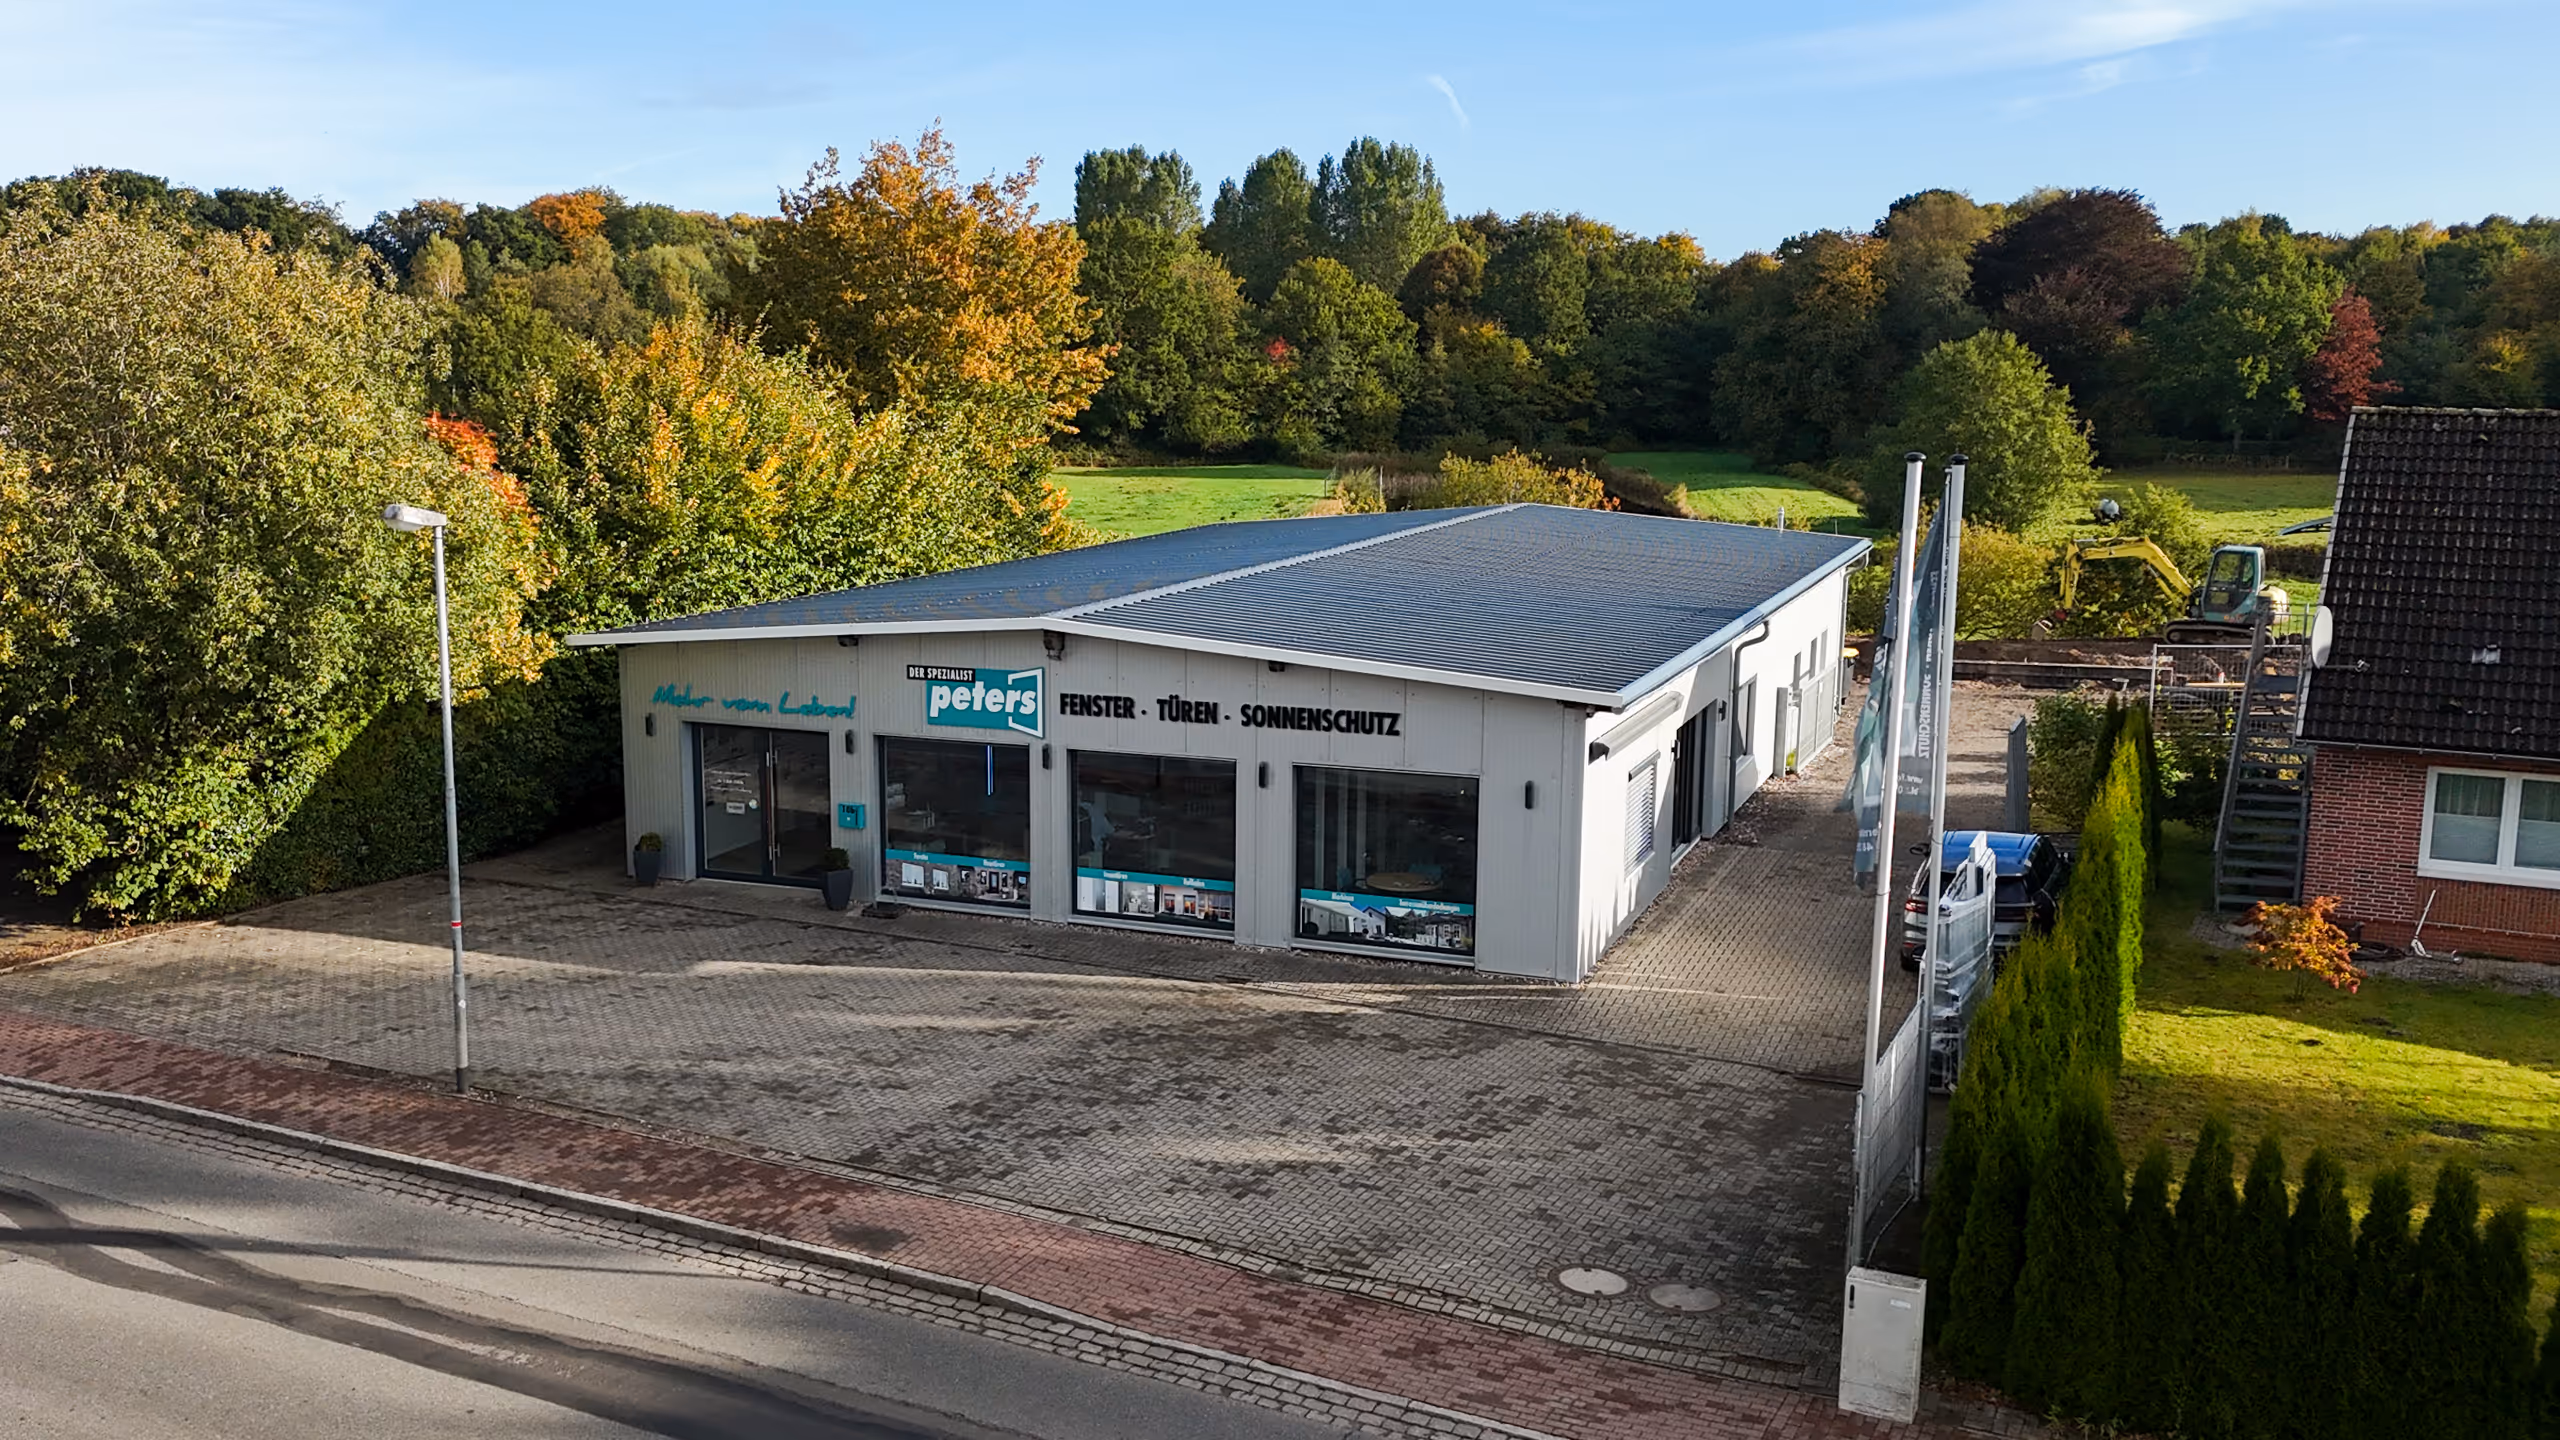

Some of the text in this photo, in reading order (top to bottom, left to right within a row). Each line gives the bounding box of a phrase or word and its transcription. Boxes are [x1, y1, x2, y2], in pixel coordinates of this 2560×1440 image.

[909, 666, 974, 681] DER SPEZIALIST
[652, 682, 714, 708] Mehr
[722, 697, 771, 714] vom
[930, 681, 1036, 717] peters
[1059, 693, 1402, 737] FENSTER TÜREN SONNENSCHUTZ
